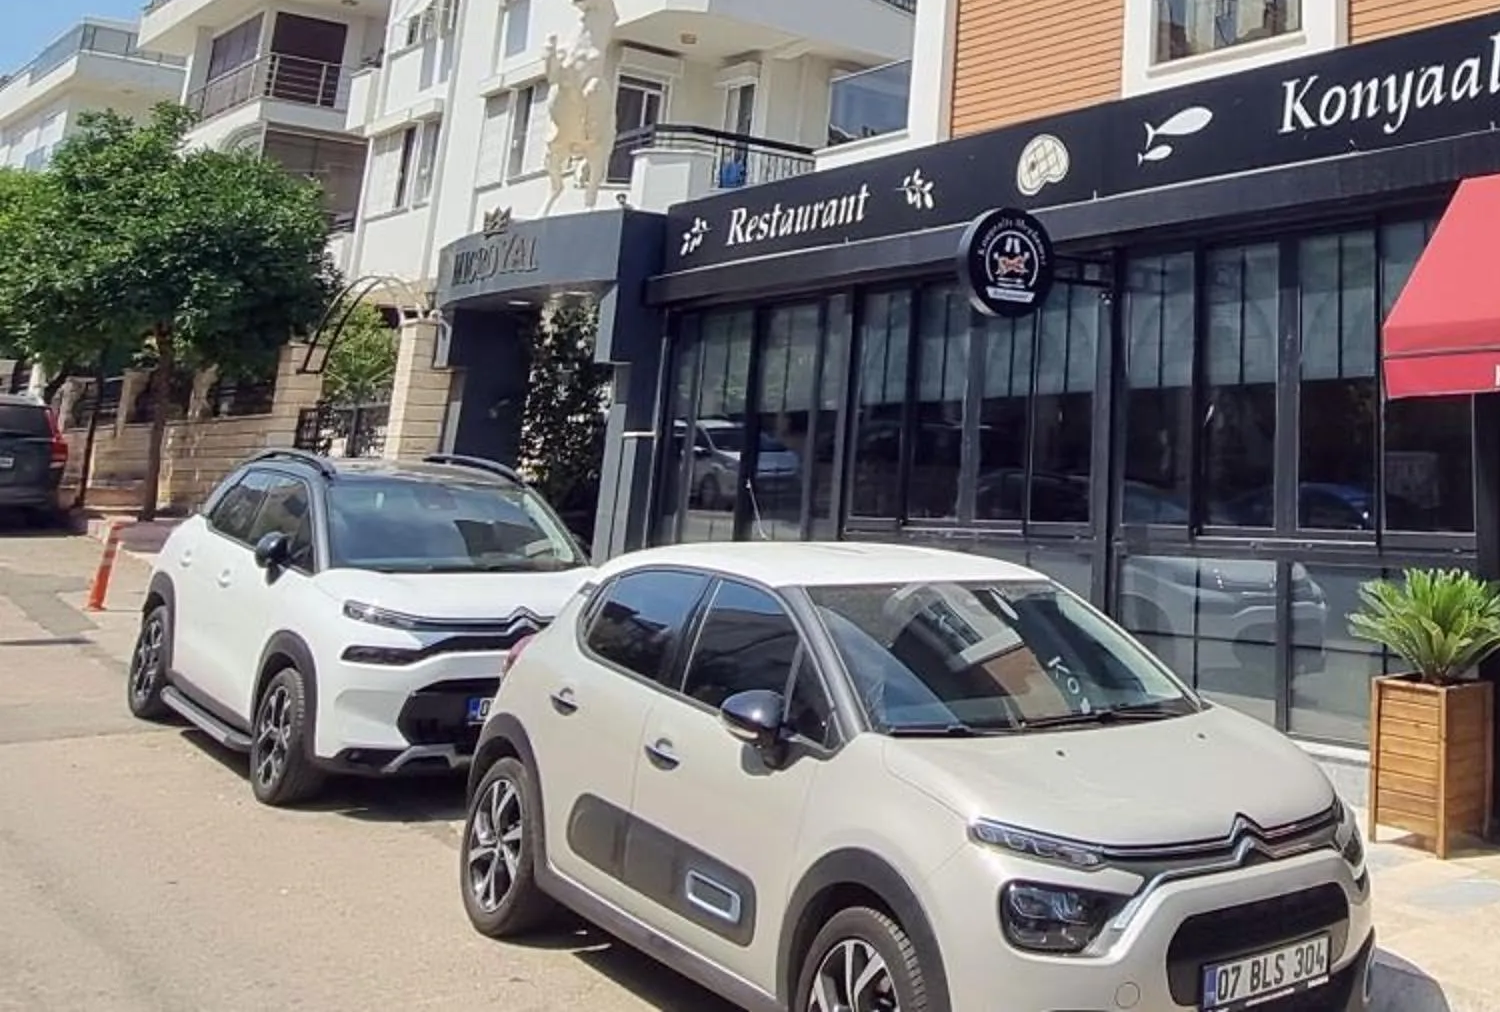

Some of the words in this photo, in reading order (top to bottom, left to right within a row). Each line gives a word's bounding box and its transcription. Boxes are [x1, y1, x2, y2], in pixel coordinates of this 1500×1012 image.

[725, 183, 871, 246] Restaurant
[1217, 965, 1241, 1001] 07
[1250, 952, 1285, 992] BLS
[1294, 941, 1325, 979] 304
